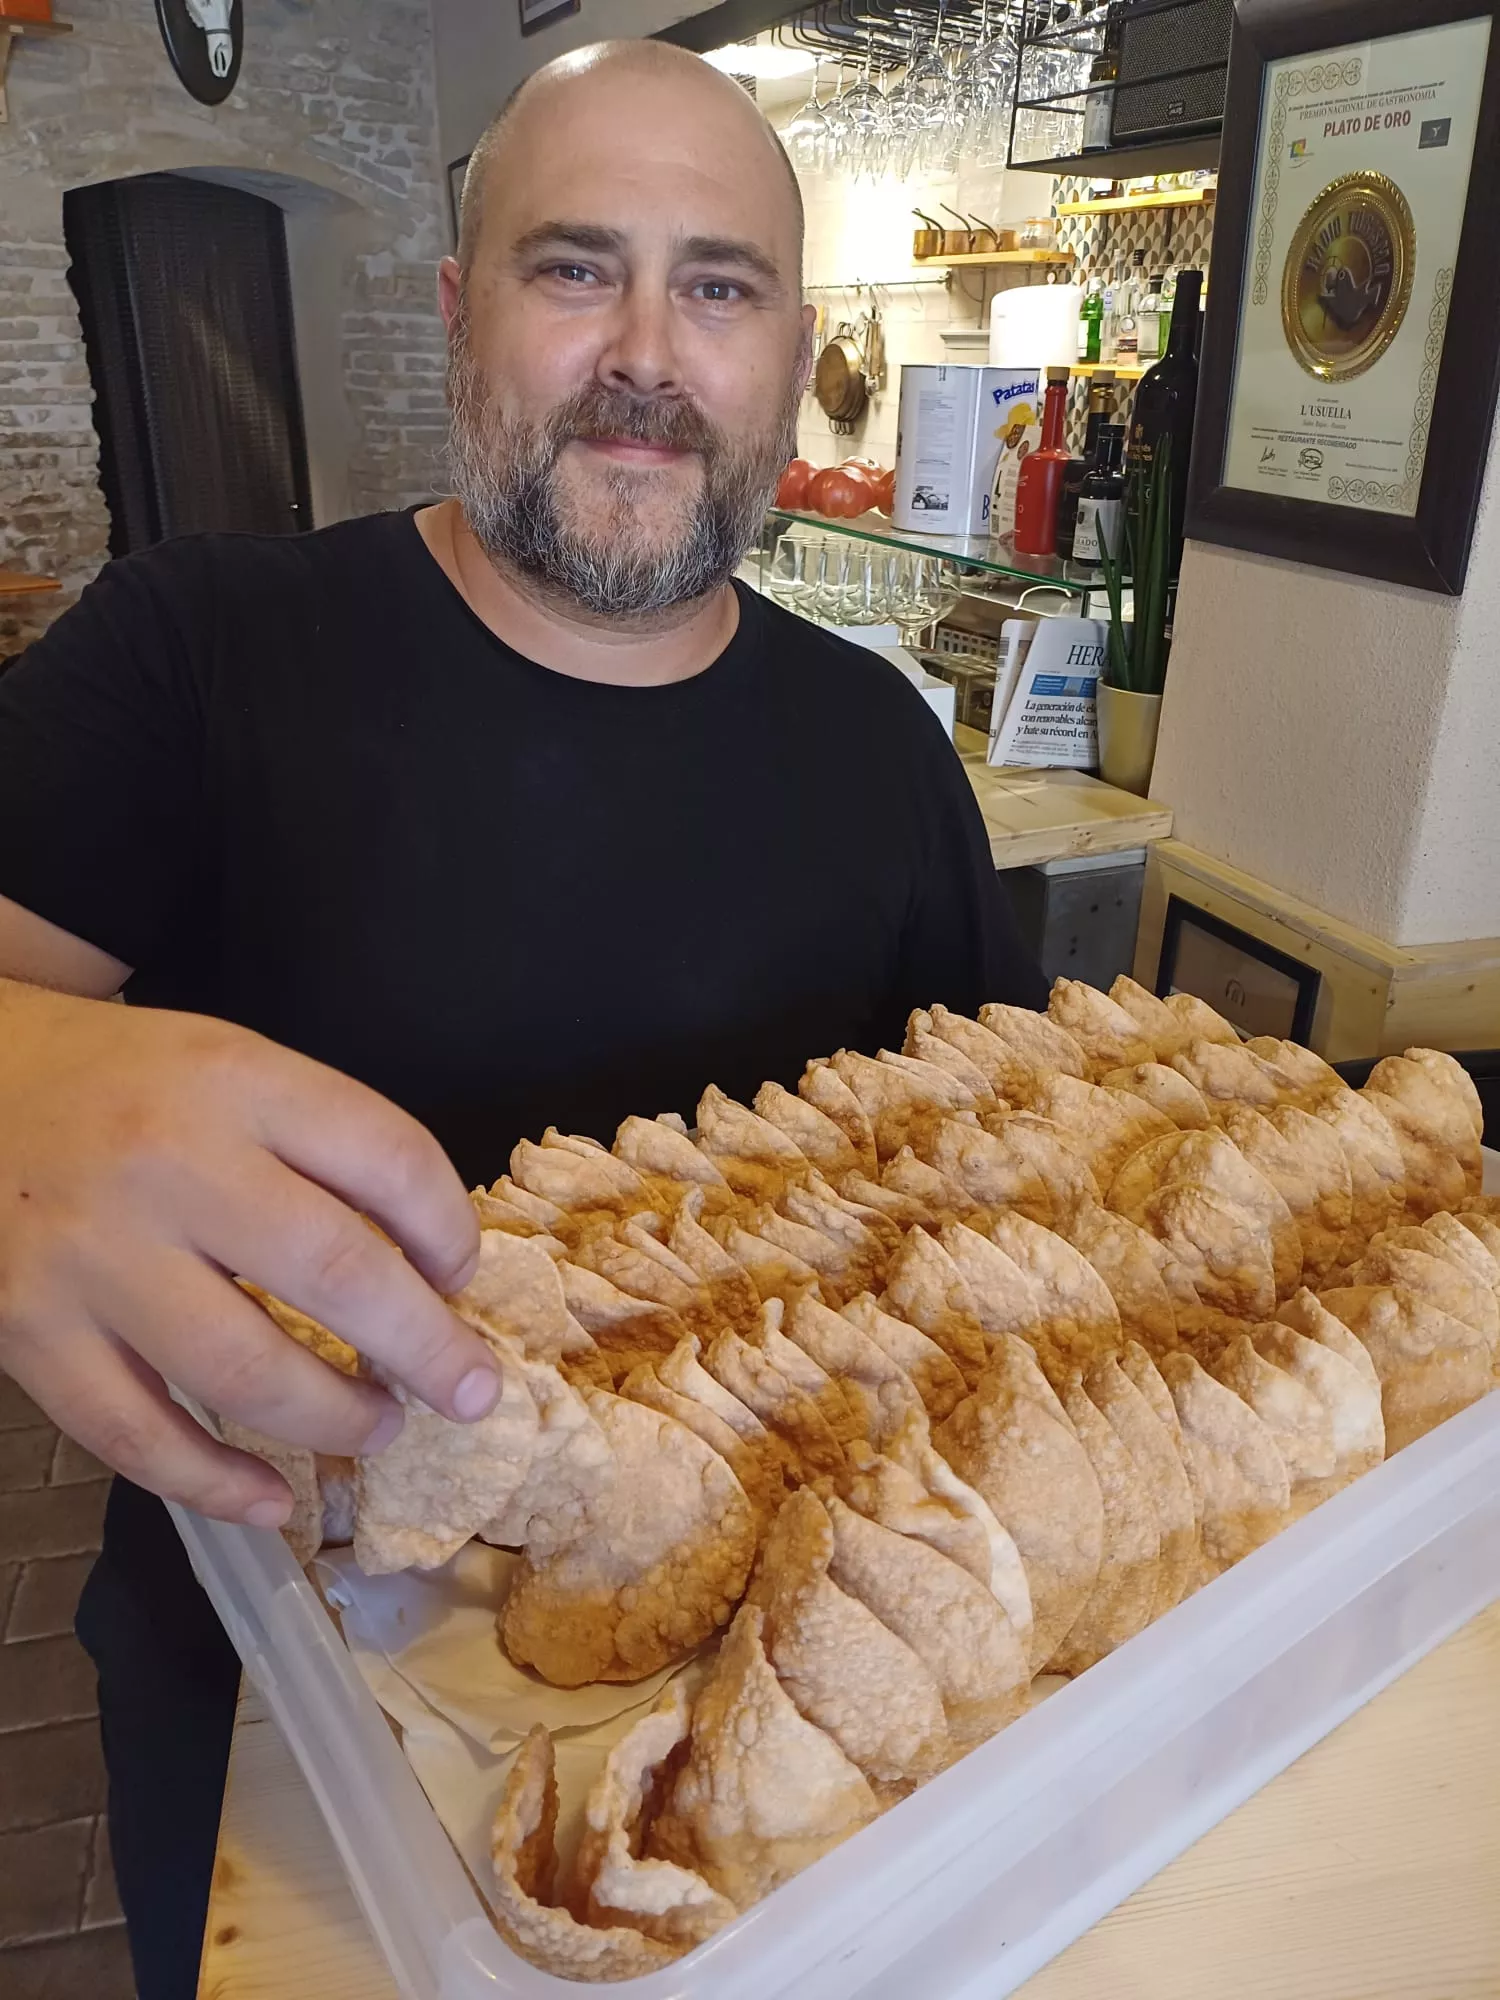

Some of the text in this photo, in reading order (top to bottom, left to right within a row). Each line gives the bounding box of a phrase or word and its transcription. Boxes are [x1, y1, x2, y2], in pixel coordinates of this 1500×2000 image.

[1299, 107, 1328, 121] PREMIO
[1327, 101, 1366, 116] NACIONAL
[1366, 98, 1379, 110] DE
[1323, 109, 1412, 138] PLATO DE ORO
[1277, 434, 1317, 446] RESTAURANTE
[1066, 644, 1105, 667] HER
[1024, 699, 1034, 711] La
[1034, 701, 1075, 713] generación
[1075, 702, 1086, 713] de
[1020, 714, 1097, 726] con renovables alcan
[1015, 725, 1021, 736] y
[1039, 728, 1050, 736] su
[1049, 725, 1077, 738] récord
[1077, 730, 1089, 739] en
